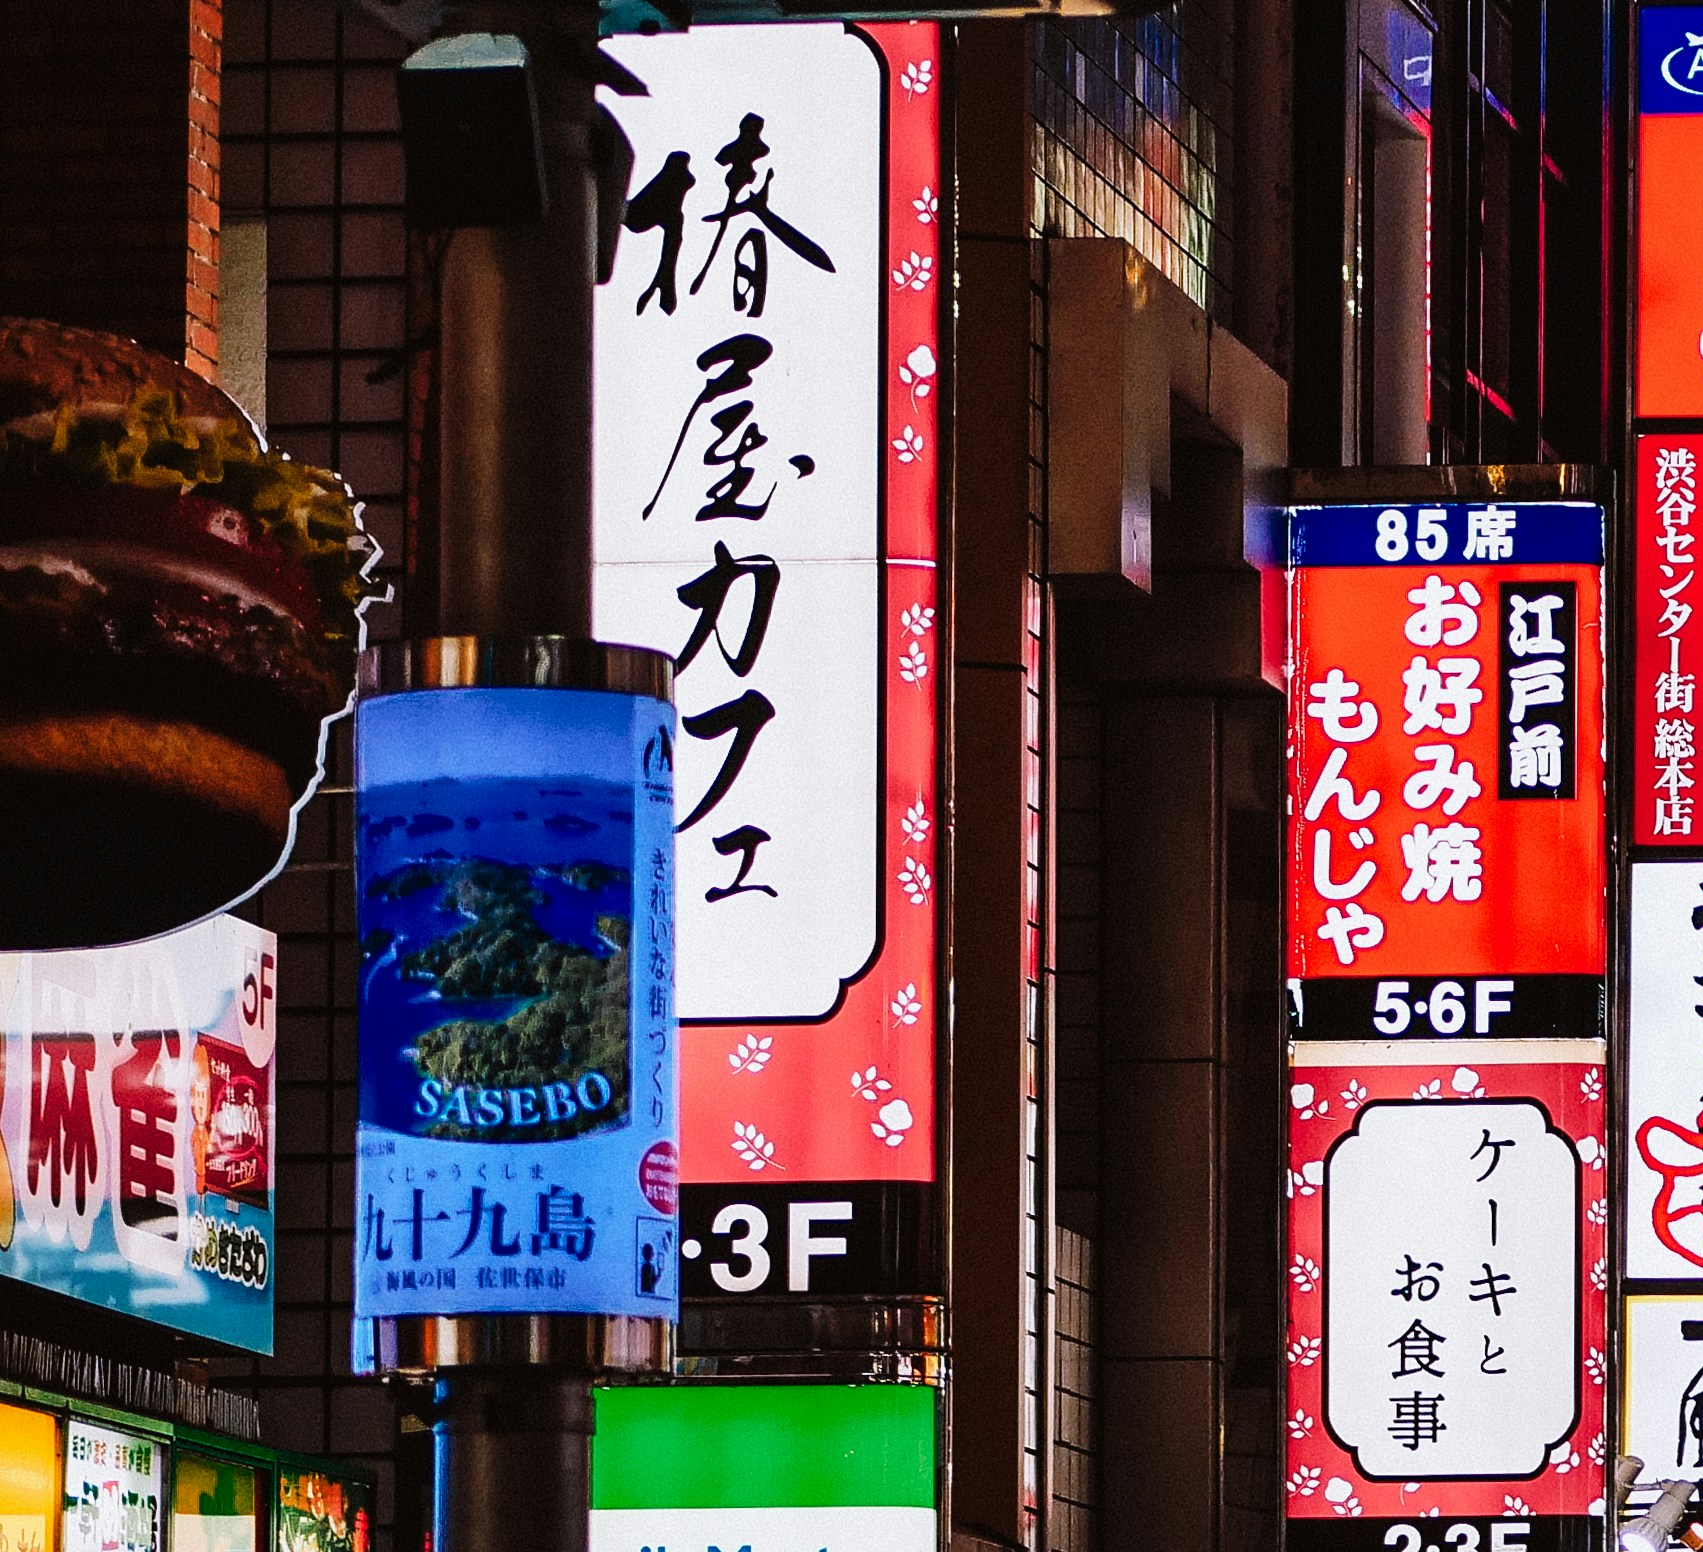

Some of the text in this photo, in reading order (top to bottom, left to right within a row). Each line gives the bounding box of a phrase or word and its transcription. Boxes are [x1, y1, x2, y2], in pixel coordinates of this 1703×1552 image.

[626, 113, 836, 902] 椿屋カフェ
[1375, 505, 1516, 561] 85席
[1401, 574, 1484, 903] お好み焼
[1508, 595, 1566, 788] 江戸前
[1304, 668, 1385, 966] もんじゃ
[242, 946, 275, 1031] 5F
[414, 1071, 612, 1129] SASEBO
[362, 1184, 596, 1264] 九十九島
[1468, 1128, 1518, 1376] ケーキと
[1387, 1253, 1448, 1452] お食事
